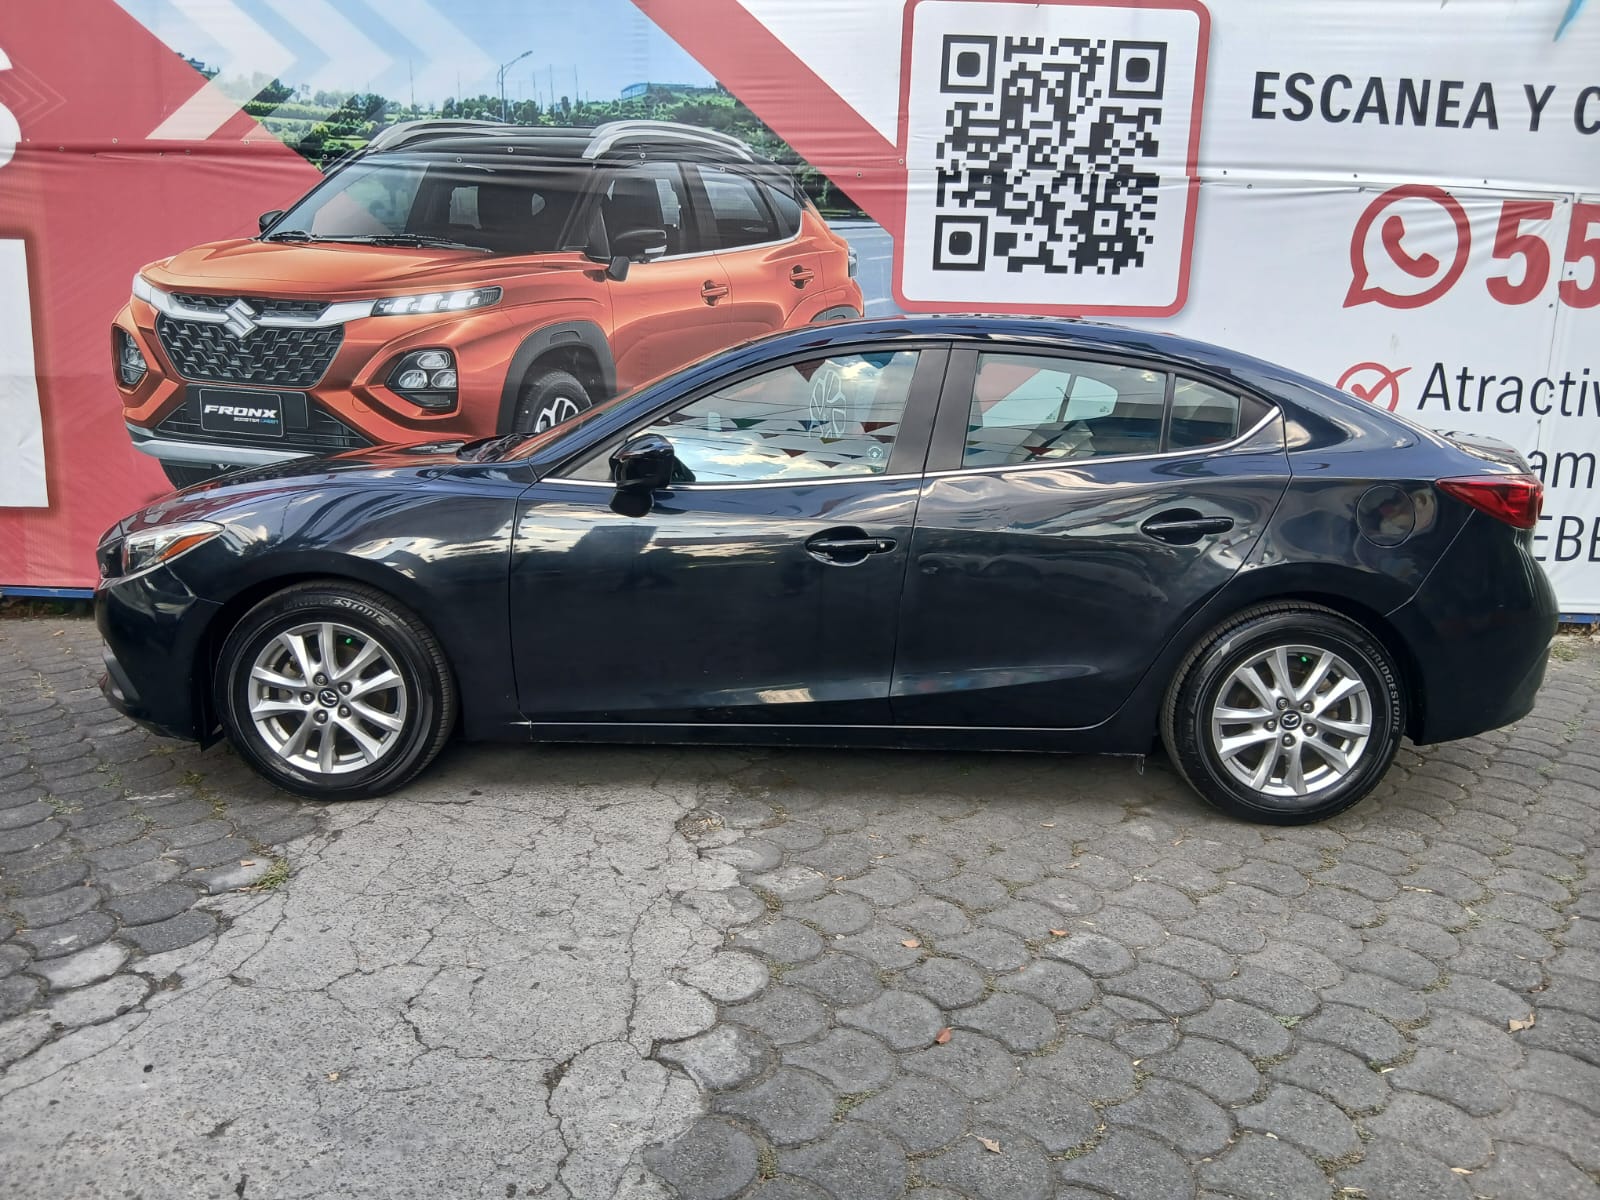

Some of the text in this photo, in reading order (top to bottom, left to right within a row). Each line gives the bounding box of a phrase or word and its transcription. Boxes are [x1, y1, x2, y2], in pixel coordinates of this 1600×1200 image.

[1251, 71, 1499, 130] ESCANEA
[1523, 84, 1556, 132] Y
[203, 404, 278, 418] FRONX
